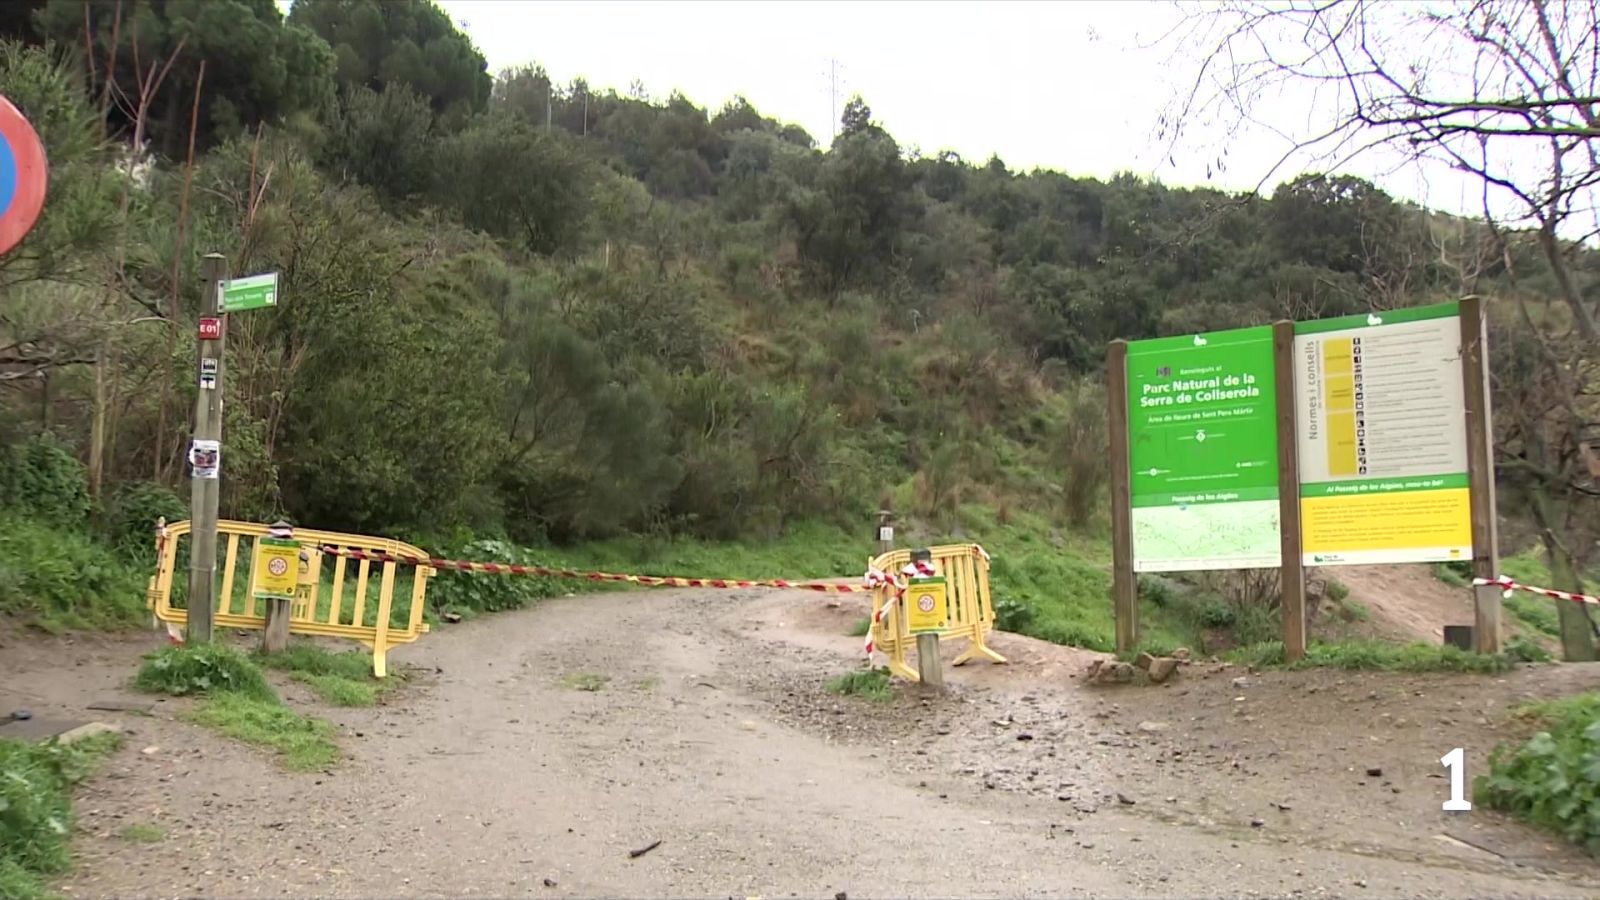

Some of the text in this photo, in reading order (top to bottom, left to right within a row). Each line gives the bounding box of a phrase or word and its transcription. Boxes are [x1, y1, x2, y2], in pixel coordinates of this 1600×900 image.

[200, 324, 217, 334] E 01
[1305, 341, 1315, 386] consells
[1143, 372, 1256, 395] Parc Natural de la
[1140, 385, 1260, 408] Serra de Collserola
[1307, 397, 1318, 440] Normes
